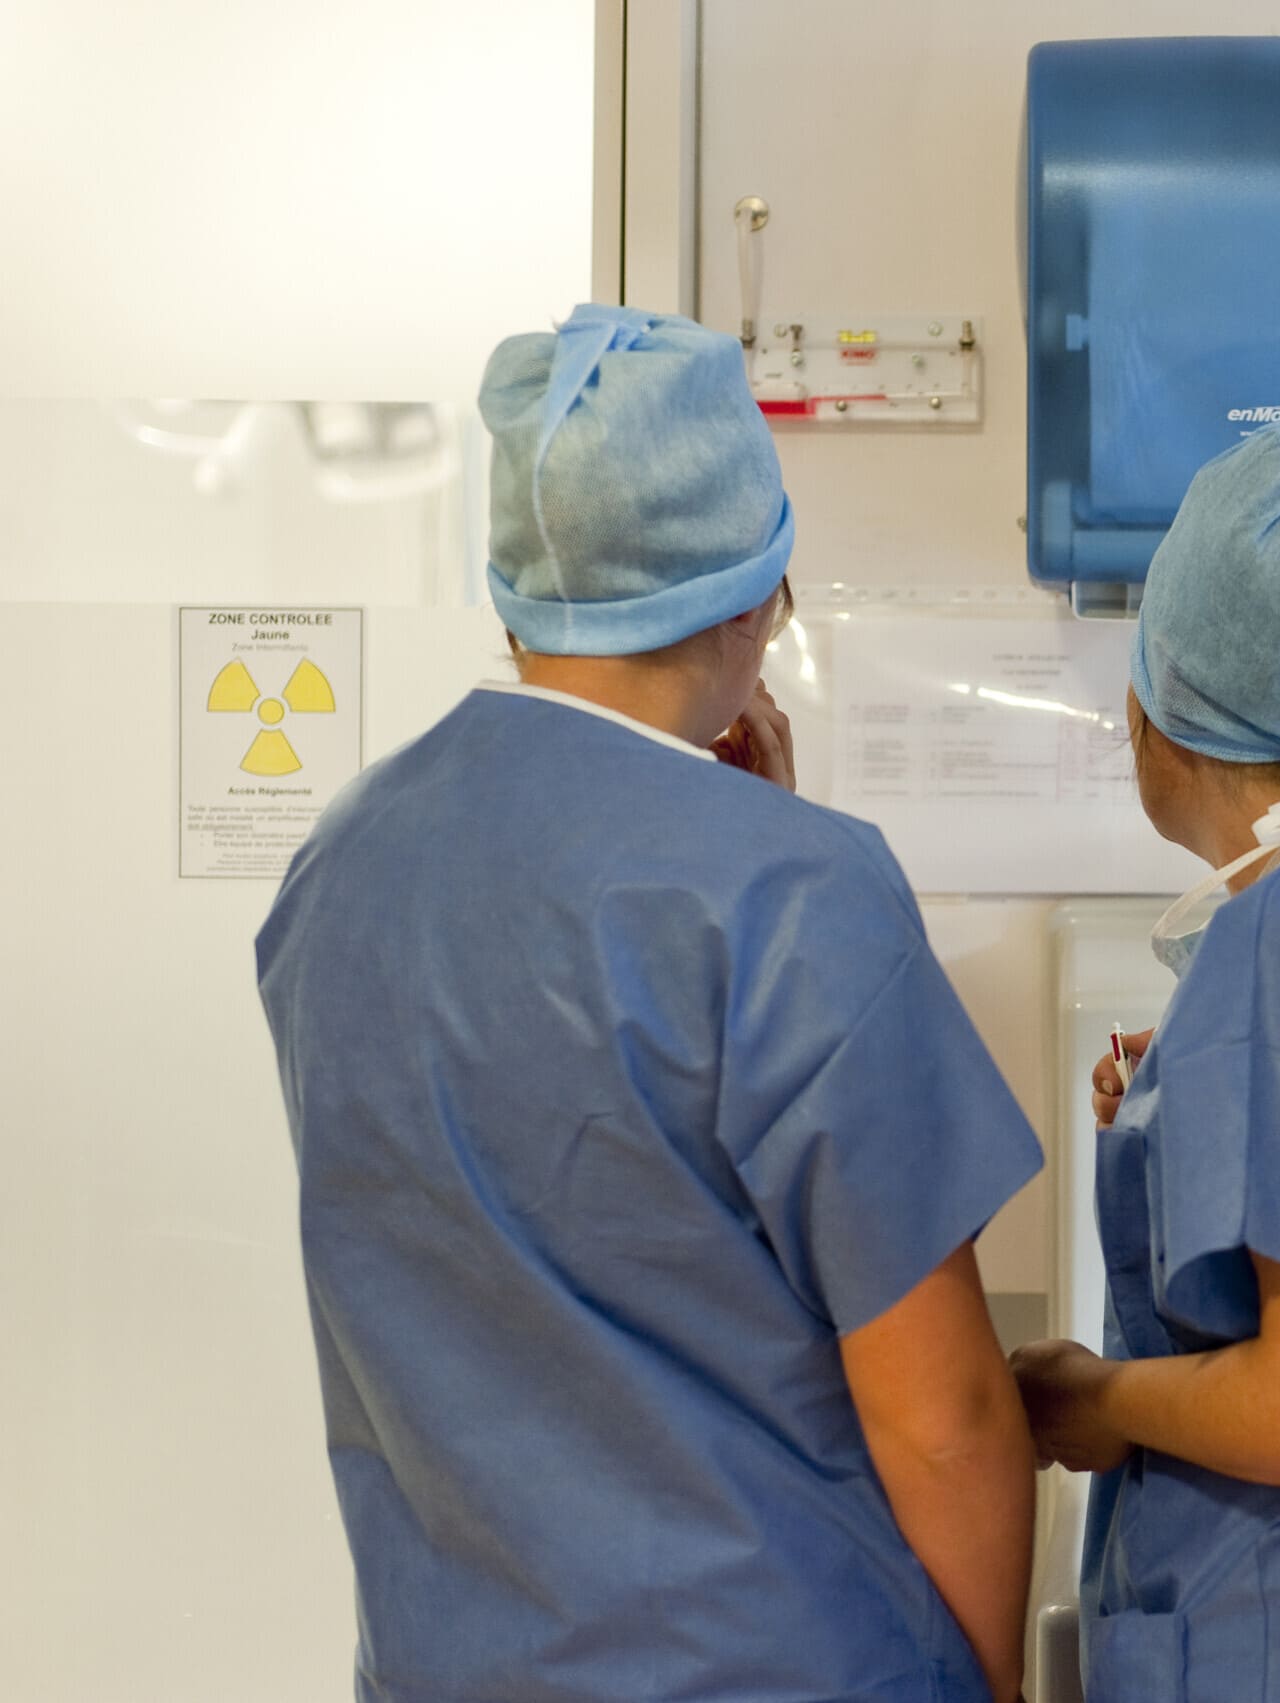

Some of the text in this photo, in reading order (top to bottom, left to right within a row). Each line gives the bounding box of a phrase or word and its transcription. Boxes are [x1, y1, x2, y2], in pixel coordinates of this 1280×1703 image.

[208, 613, 334, 626] ZONE CONTROLEE
[251, 629, 290, 641] Jaune
